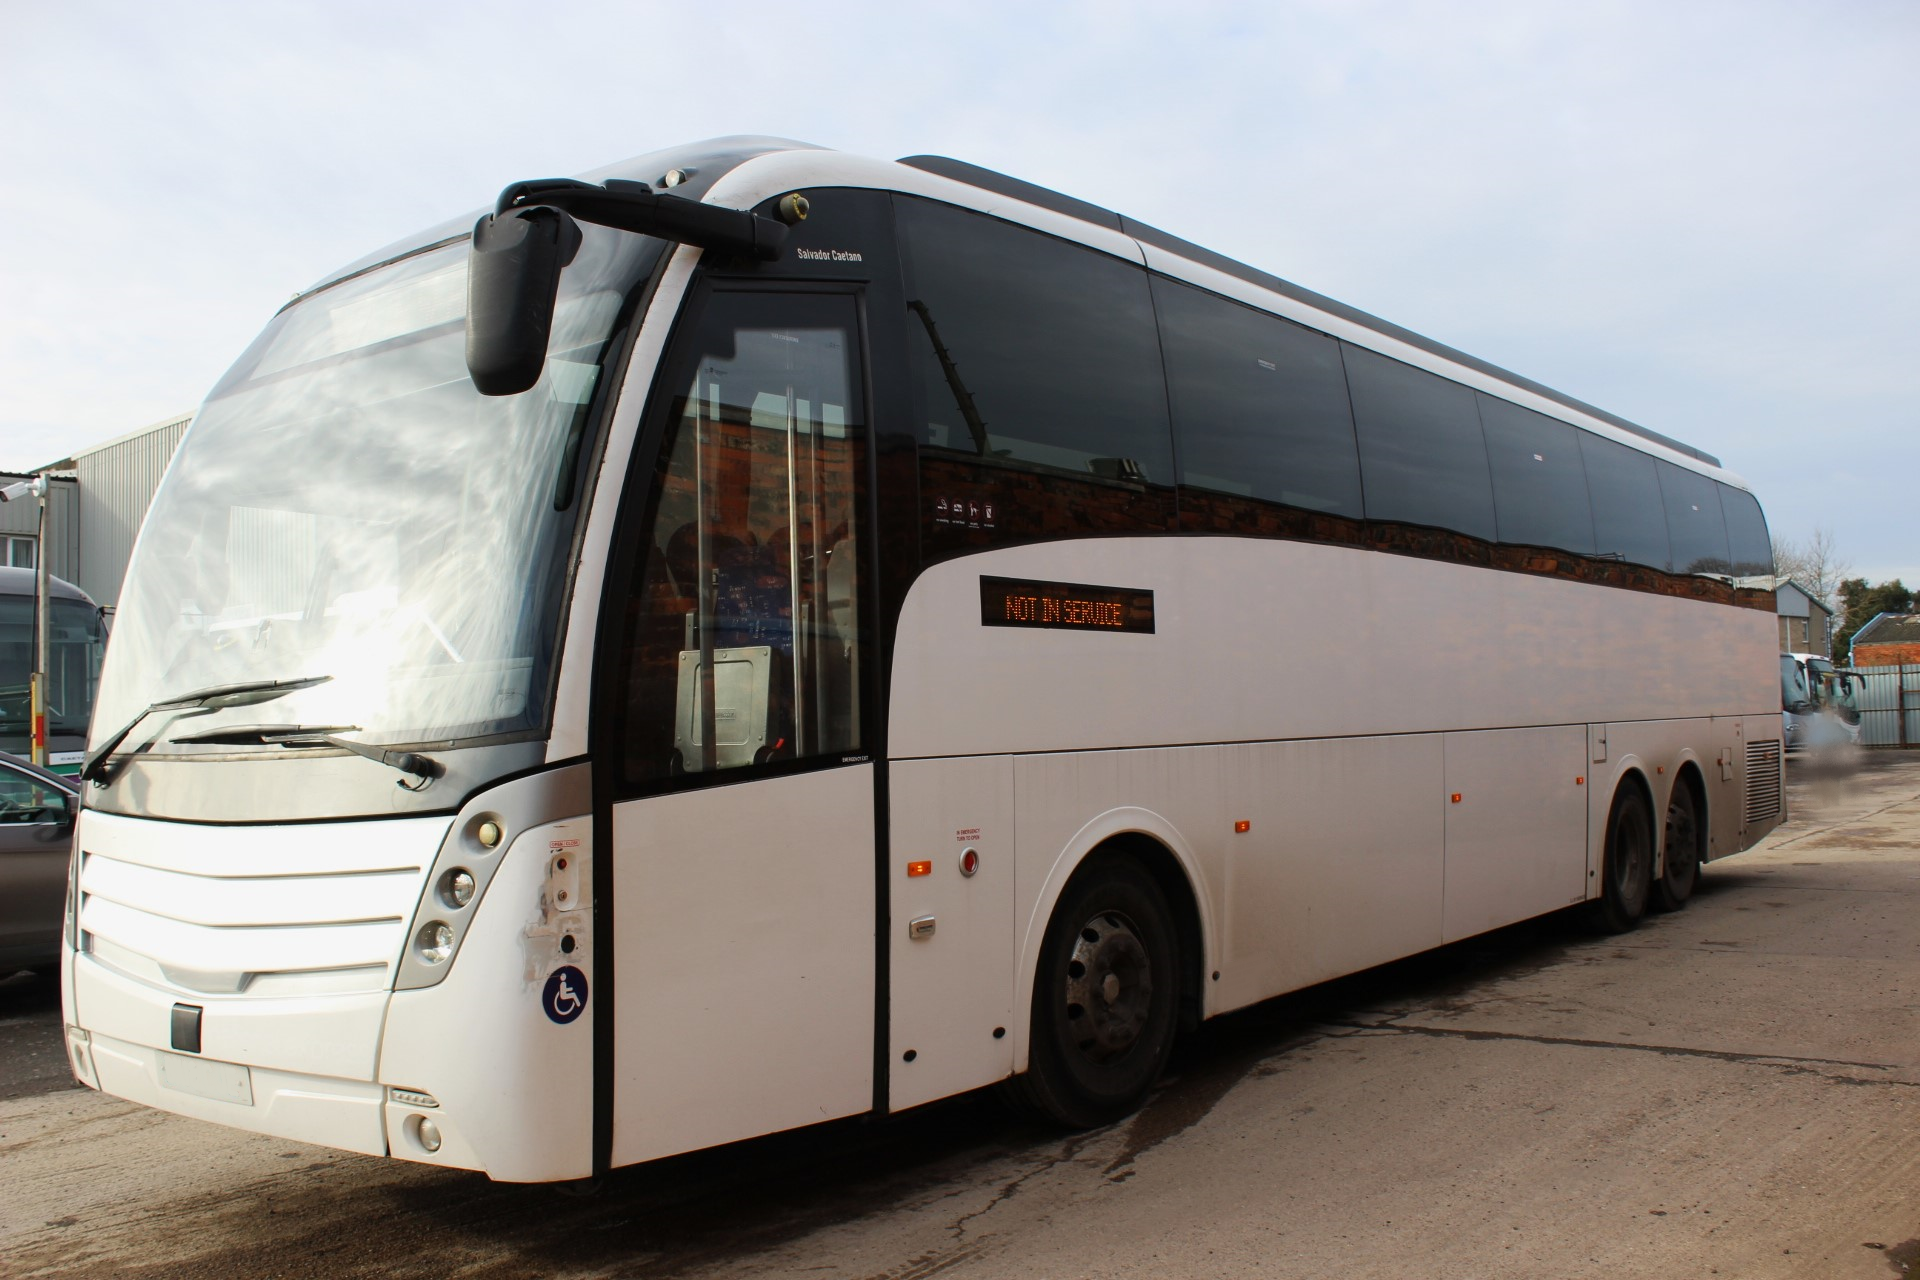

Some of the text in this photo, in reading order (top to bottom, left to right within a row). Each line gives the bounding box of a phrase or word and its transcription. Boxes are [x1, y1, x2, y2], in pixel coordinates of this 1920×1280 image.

[797, 248, 862, 262] Salvador Caetano
[1006, 596, 1122, 626] NOT IN SERVICE
